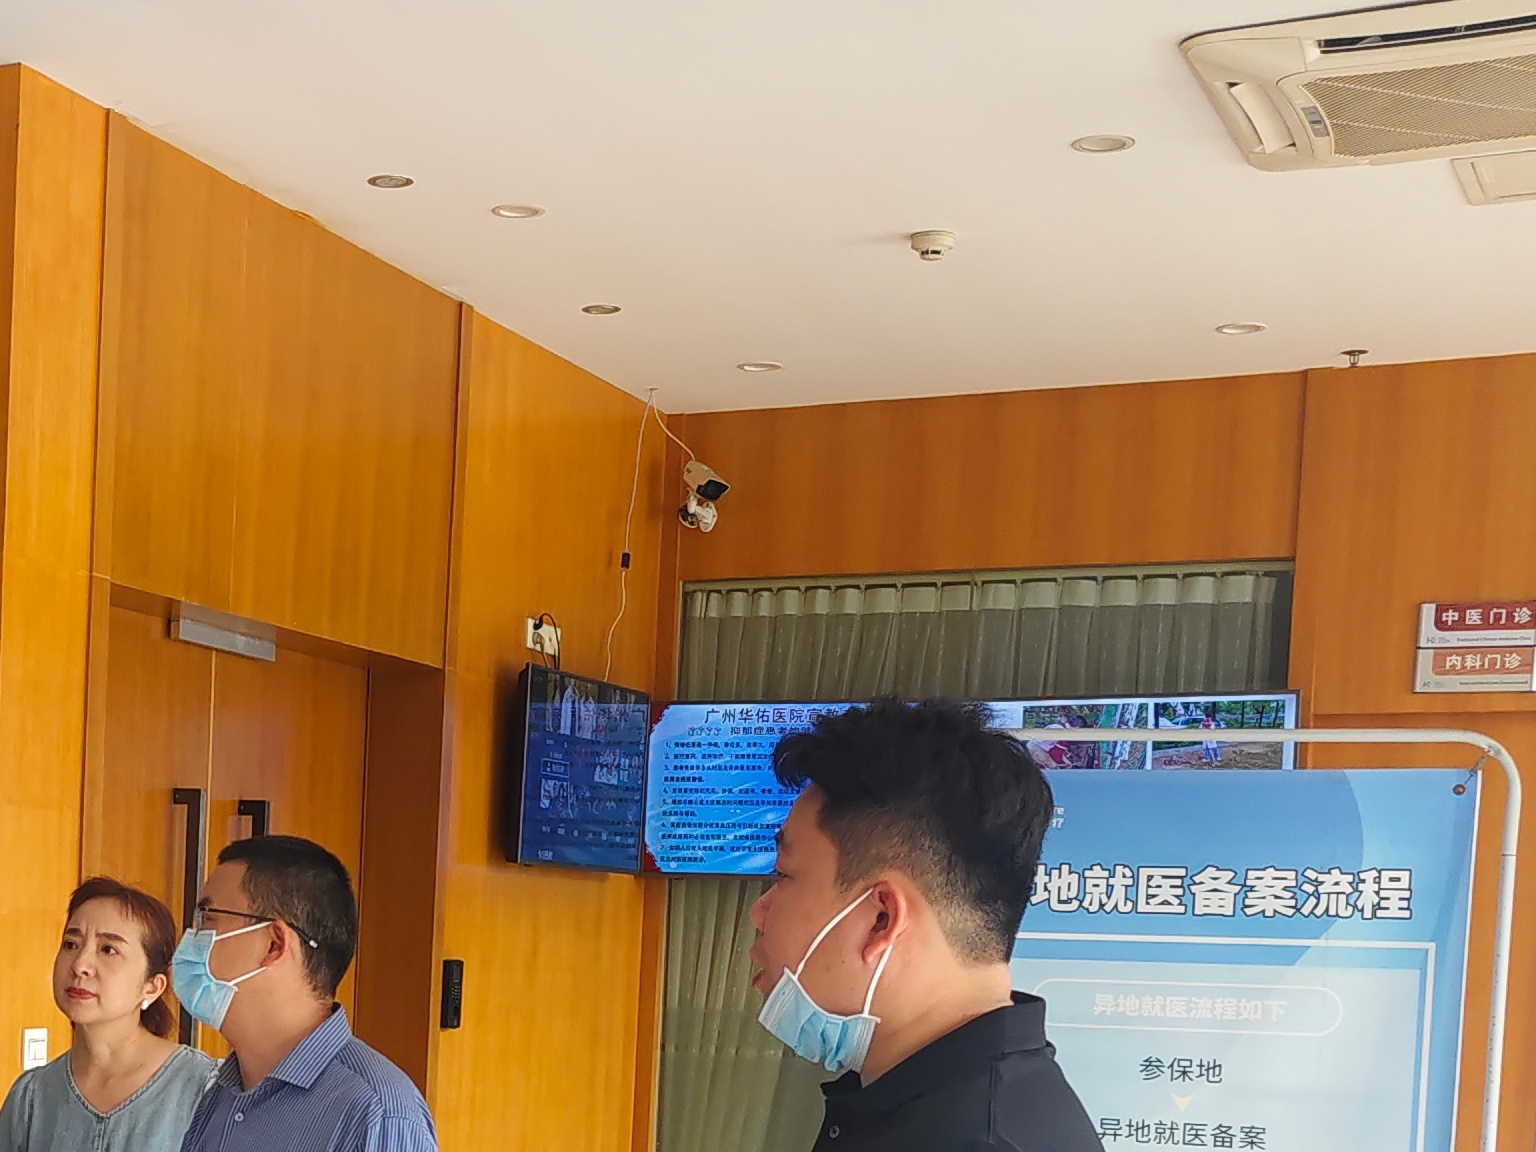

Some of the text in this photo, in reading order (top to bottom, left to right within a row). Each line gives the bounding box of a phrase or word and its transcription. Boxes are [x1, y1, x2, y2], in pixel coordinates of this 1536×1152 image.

[1441, 607, 1533, 626] 中医门诊
[1445, 652, 1522, 670] 内科门诊
[1030, 862, 1413, 919] 地就医备案流程
[1092, 993, 1288, 1022] 异地就医流程如下
[1138, 1055, 1223, 1083] 参保地
[1097, 1118, 1266, 1150] 异地就医备案
